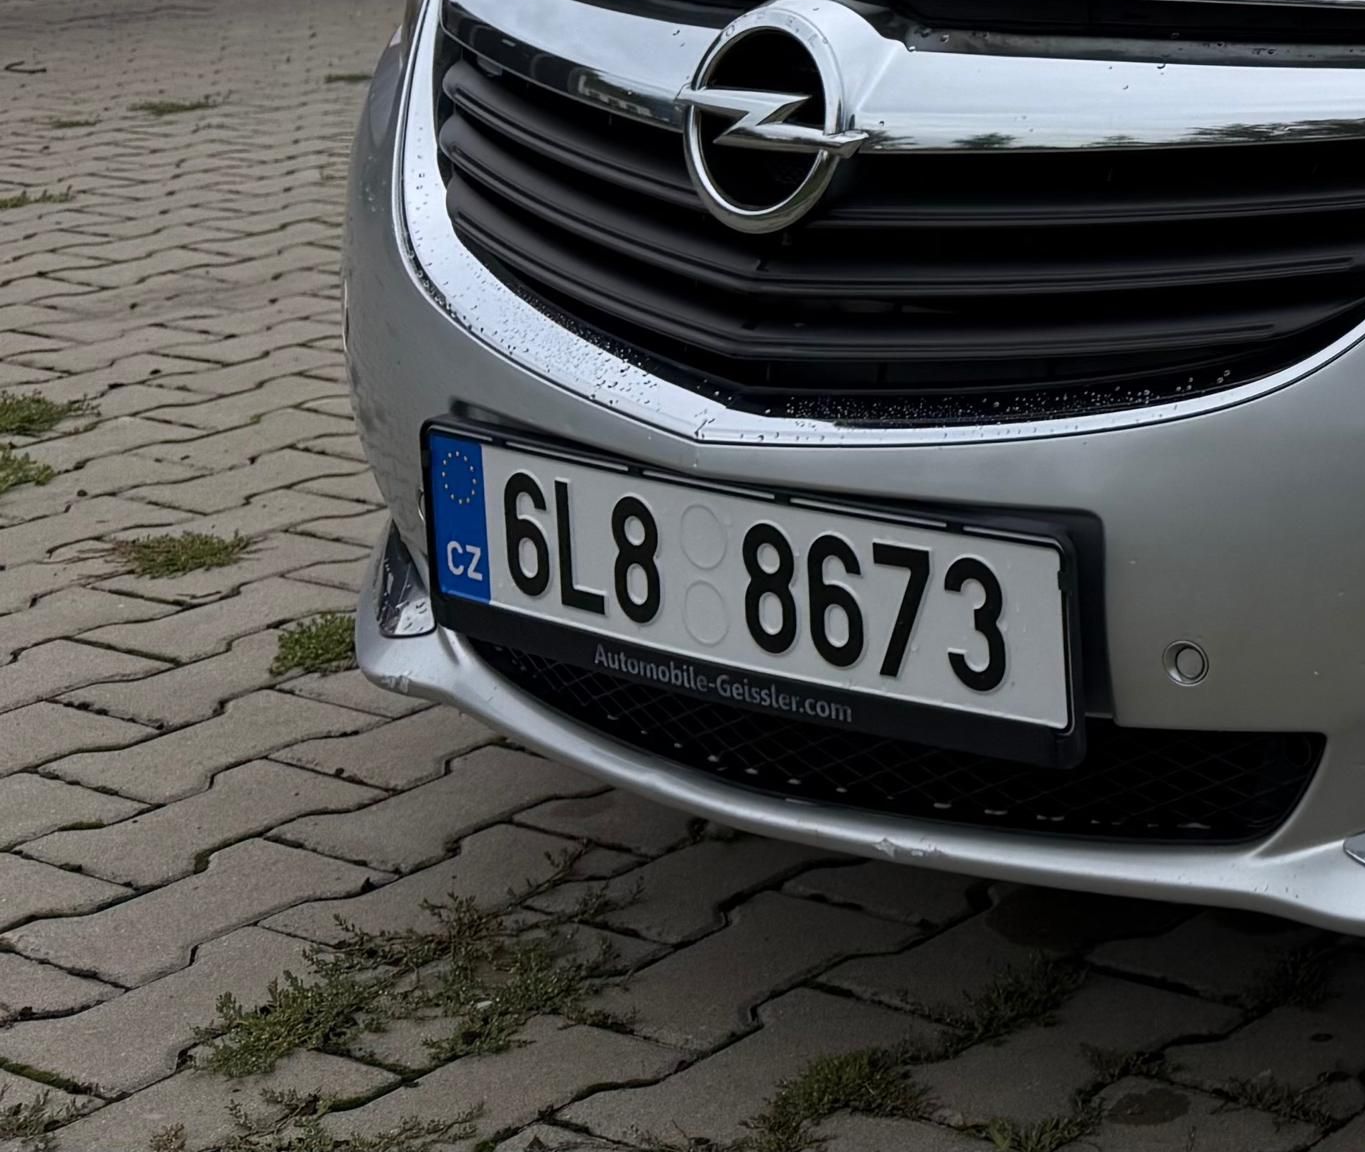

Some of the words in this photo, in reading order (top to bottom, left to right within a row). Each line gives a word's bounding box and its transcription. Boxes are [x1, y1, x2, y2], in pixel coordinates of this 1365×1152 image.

[446, 540, 484, 582] CZ
[502, 470, 662, 625] 6L8
[741, 521, 1007, 693] 8673
[594, 644, 853, 724] Automobile-Geissler.com
